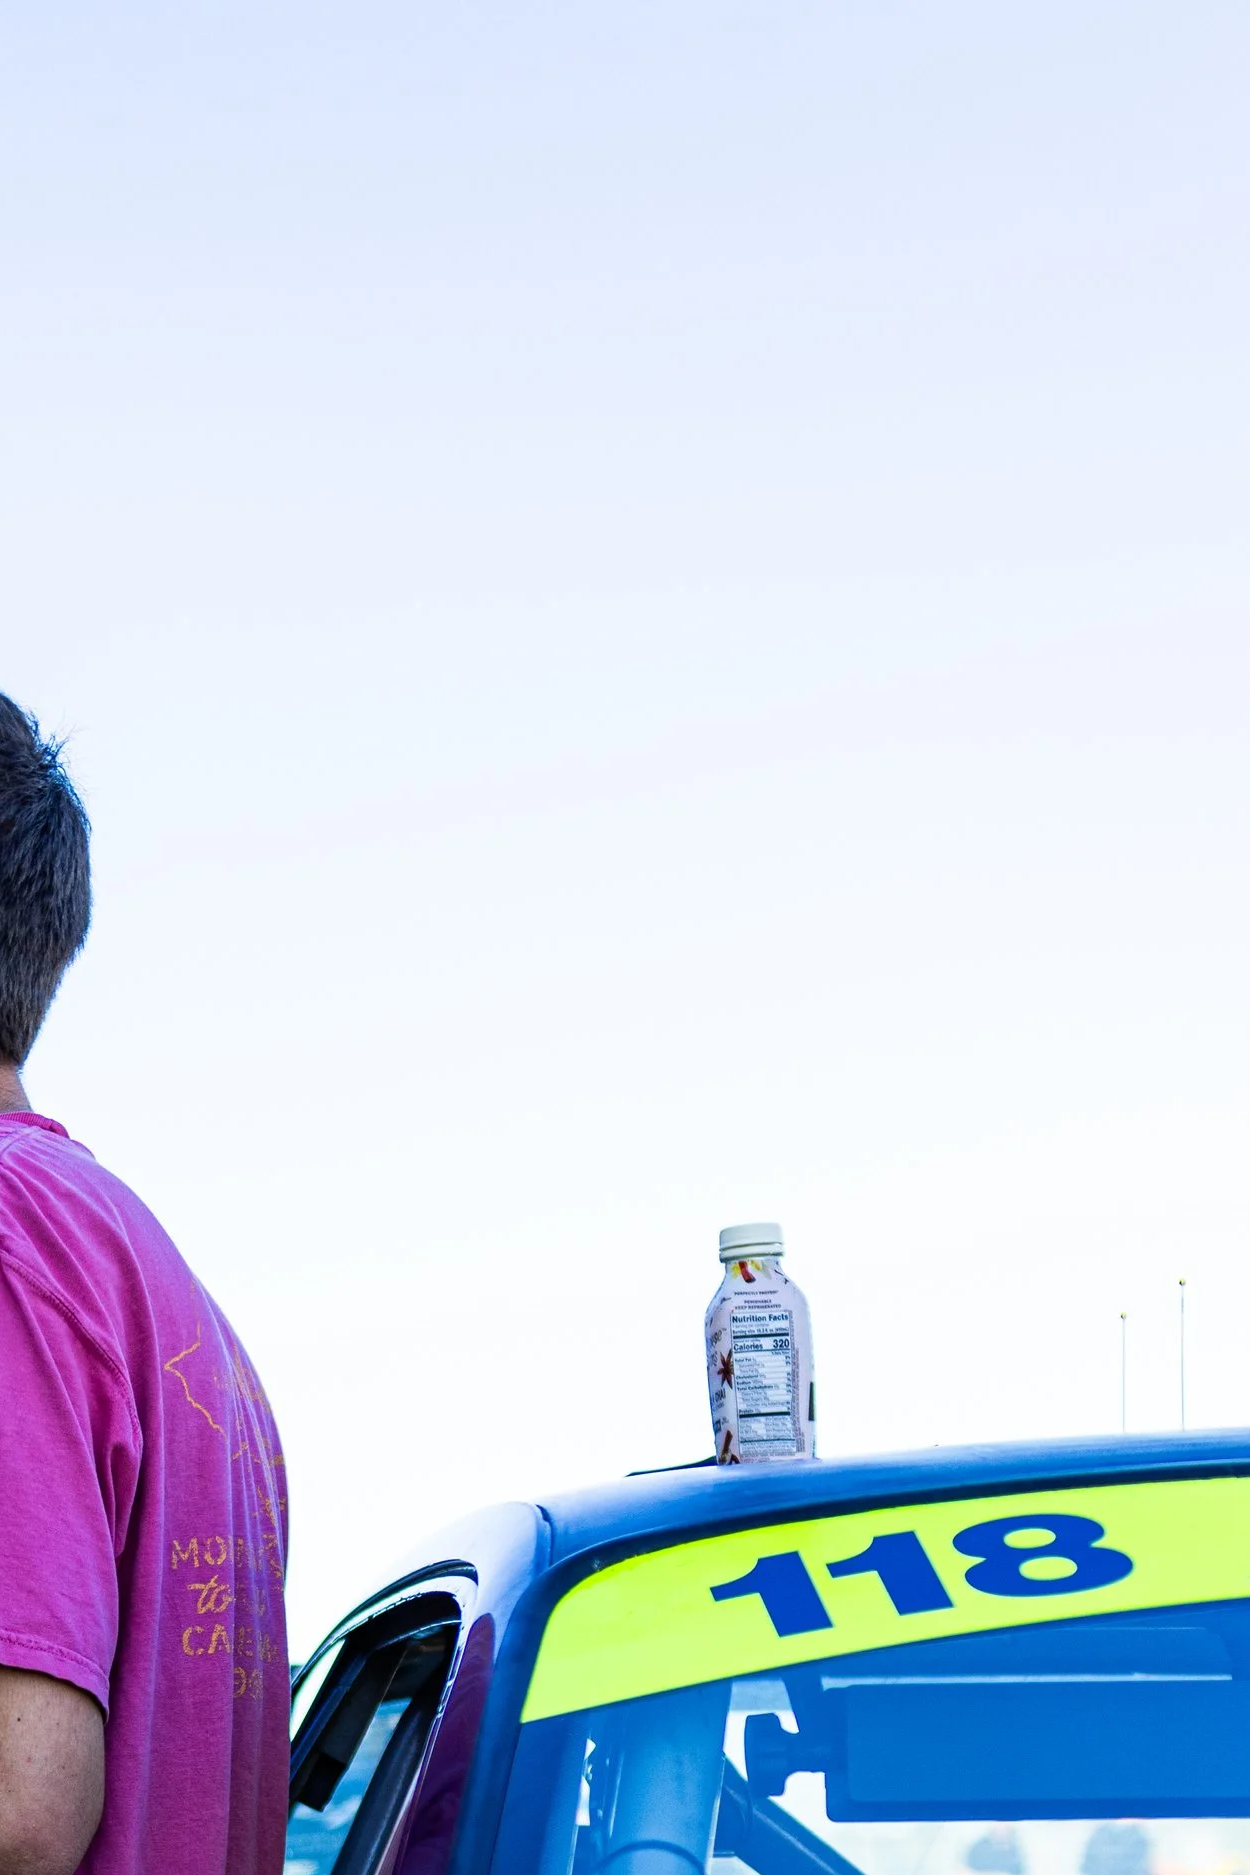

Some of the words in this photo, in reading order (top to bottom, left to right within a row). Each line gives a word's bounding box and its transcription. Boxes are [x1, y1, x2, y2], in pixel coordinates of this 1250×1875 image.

[732, 1314, 767, 1323] Nutrition
[768, 1313, 789, 1322] Facts
[733, 1342, 764, 1351] Calories
[772, 1338, 790, 1349] 320
[710, 1513, 1134, 1637] 118
[187, 1574, 236, 1614] to
